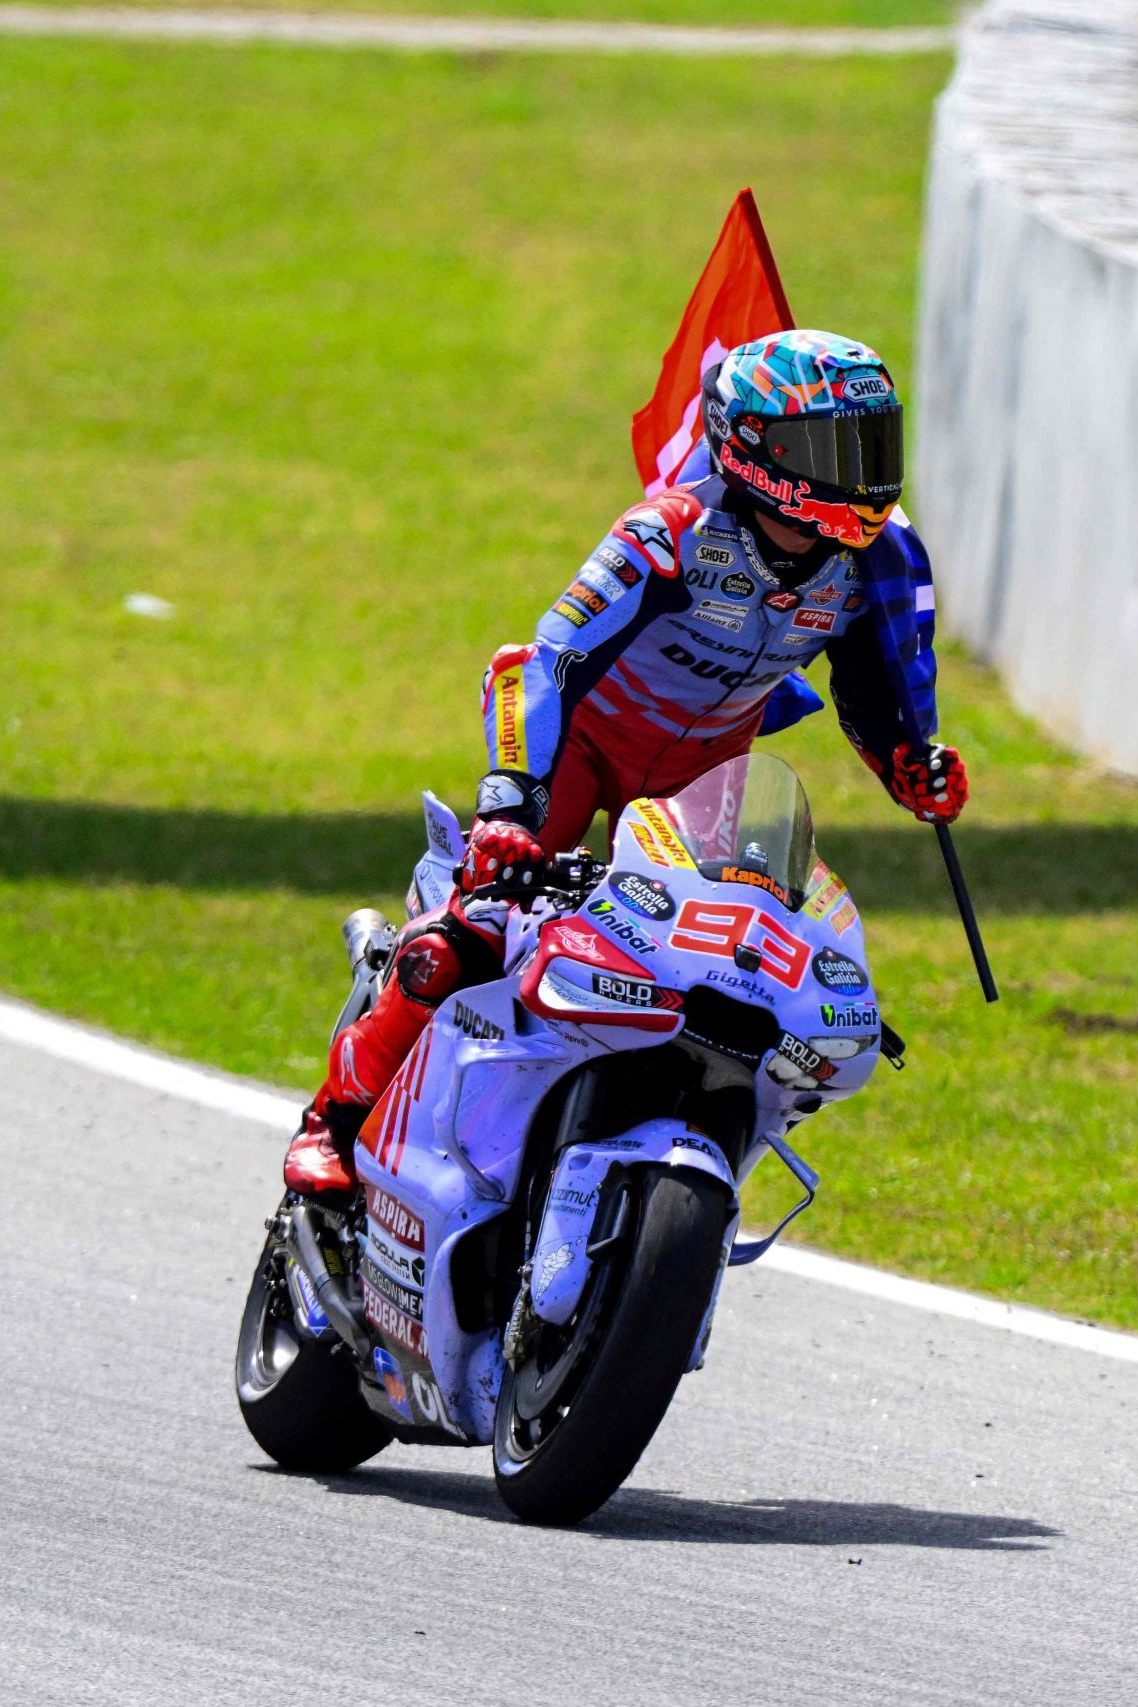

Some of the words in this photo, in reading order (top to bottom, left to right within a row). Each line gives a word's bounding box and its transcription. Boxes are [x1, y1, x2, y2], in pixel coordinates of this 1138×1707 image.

[709, 404, 730, 438] SHOEI
[832, 408, 865, 419] GIVES
[599, 547, 626, 567] BOLD
[699, 546, 729, 564] SHOEI
[500, 675, 521, 765] Antangin
[618, 882, 658, 915] Galicia
[624, 875, 669, 910] Estrella
[721, 866, 789, 905] Kapriol
[587, 897, 658, 955] Unibat
[667, 898, 814, 993] 93
[818, 960, 857, 973] Estrella
[824, 972, 862, 986] Galicia
[599, 976, 652, 1001] BOLD
[820, 1003, 879, 1028] Unibat
[780, 1032, 821, 1069] BOLD
[372, 1188, 421, 1242] ASPIRA
[363, 1284, 414, 1348] FEDERAL
